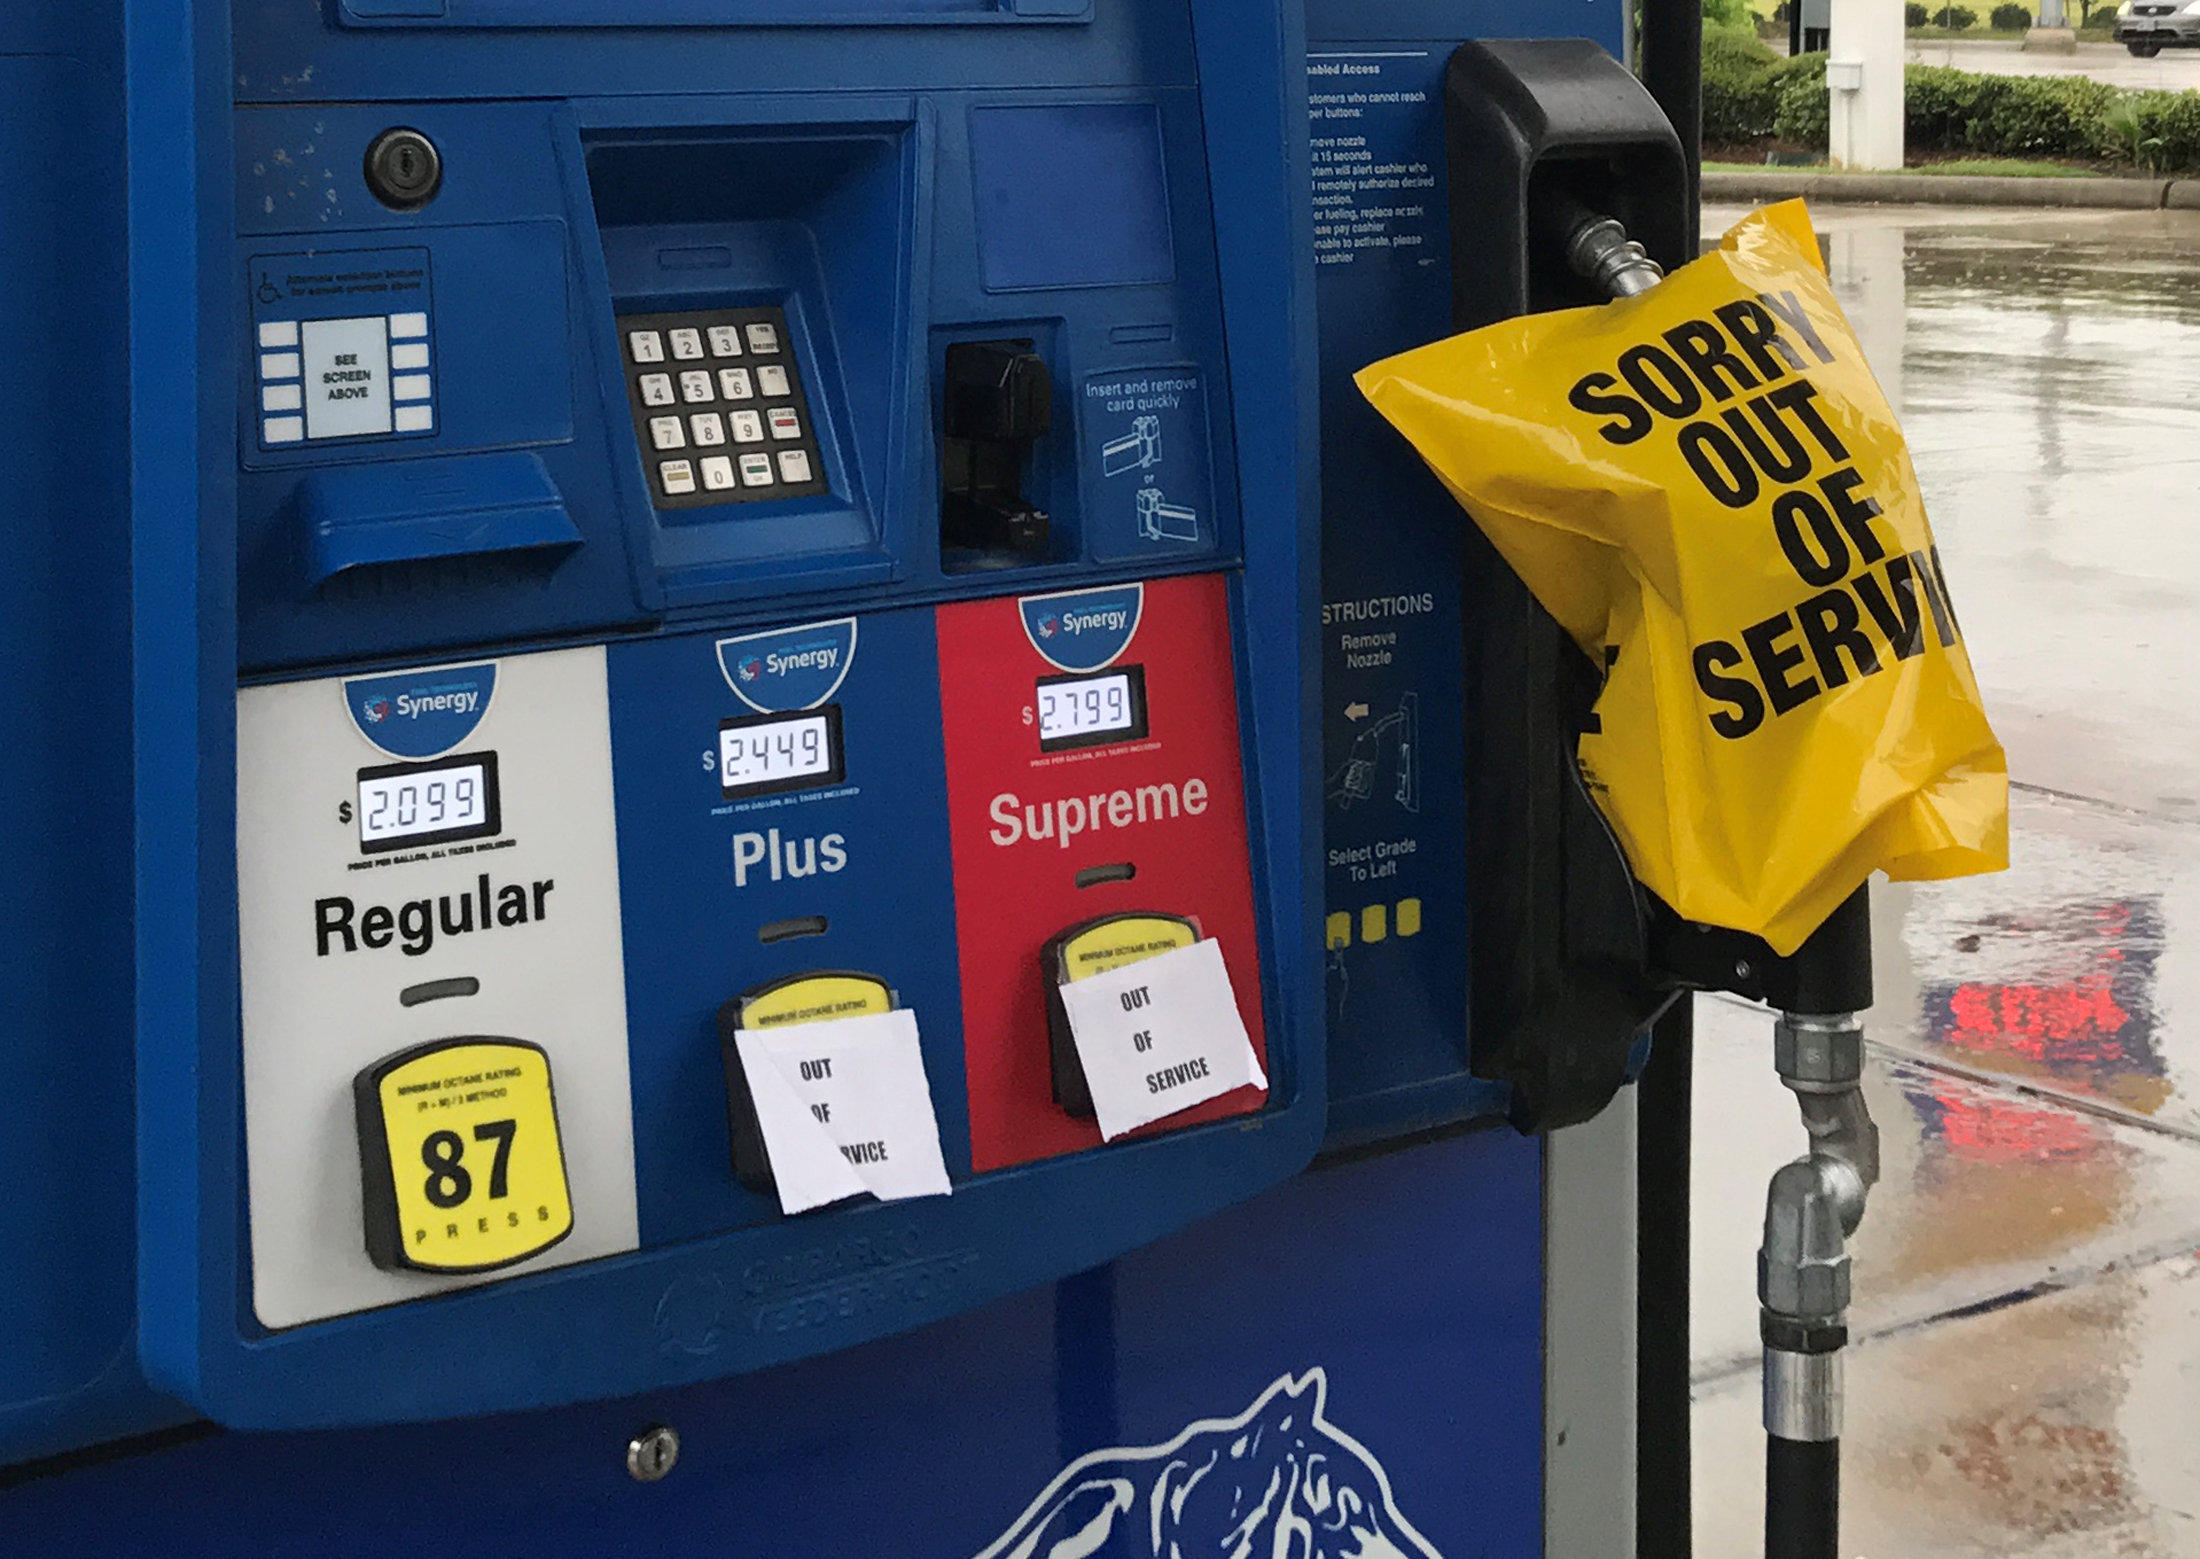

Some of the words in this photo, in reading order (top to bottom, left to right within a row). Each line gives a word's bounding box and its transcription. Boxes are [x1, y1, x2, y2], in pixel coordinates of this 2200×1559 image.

[1342, 64, 1380, 74] Access
[1347, 92, 1367, 103] who
[1369, 92, 1399, 103] cannot
[1401, 91, 1426, 102] reach
[1337, 135, 1366, 146] nozzle
[1320, 150, 1332, 162] 15
[1333, 150, 1372, 161] seconds
[644, 344, 652, 358] 1
[683, 342, 693, 355] 2
[722, 338, 732, 352] 3
[334, 354, 358, 366] SEE
[1568, 290, 1837, 446] SORRY
[322, 370, 371, 384] SCREEN
[733, 381, 742, 395] 6
[1086, 382, 1122, 398] Insert
[1124, 379, 1148, 394] and
[1150, 378, 1198, 392] remove
[328, 386, 369, 400] ABOVE
[654, 388, 664, 401] 4
[694, 384, 704, 398] 5
[1106, 396, 1134, 412] card
[1137, 393, 1180, 412] quickly
[662, 430, 672, 444] 7
[704, 427, 714, 440] 8
[743, 424, 752, 438] 9
[1676, 378, 1851, 509] OUT
[714, 470, 724, 484] 0
[1772, 466, 1886, 589] OF
[1322, 592, 1434, 624] STRUCTIONS
[1063, 611, 1127, 636] Synergy
[1341, 632, 1397, 650] Remove
[1692, 543, 1962, 740] SERVI
[766, 648, 838, 677] Synergy
[1347, 650, 1392, 668] Nozzle
[397, 691, 478, 720] Synergy
[1022, 706, 1034, 726] $
[1040, 686, 1122, 732] 2.799
[702, 750, 715, 772] $
[726, 728, 818, 777] 2.449
[339, 800, 353, 824] $
[368, 778, 474, 831] 2.099
[989, 778, 1208, 849] Supreme
[733, 828, 848, 887] Plus
[1328, 846, 1371, 866] Select
[1375, 838, 1416, 858] Grade
[1350, 866, 1366, 882] To
[1370, 860, 1396, 879] Left
[314, 872, 554, 956] Regular
[1120, 986, 1152, 1012] OUT
[1133, 1030, 1153, 1054] OF
[443, 1073, 482, 1090] OCTANE
[485, 1066, 522, 1080] RATING
[800, 1058, 832, 1082] OUT
[1146, 1057, 1210, 1094] SERVICE
[420, 1118, 517, 1209] 87
[415, 1205, 550, 1245] PRESS
